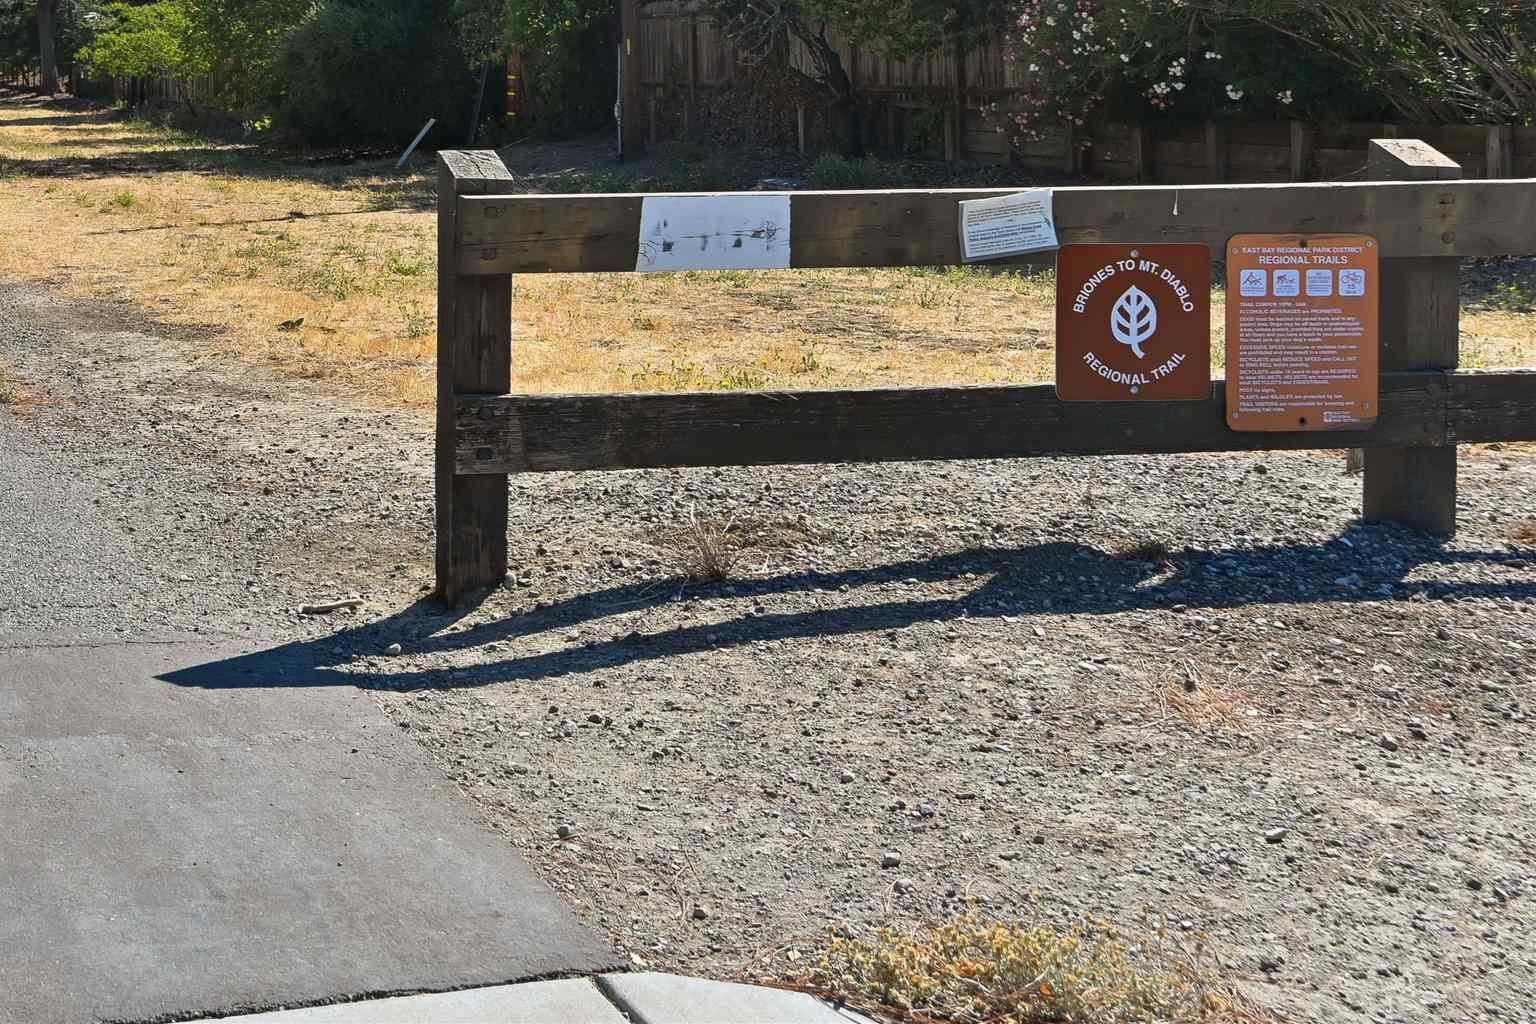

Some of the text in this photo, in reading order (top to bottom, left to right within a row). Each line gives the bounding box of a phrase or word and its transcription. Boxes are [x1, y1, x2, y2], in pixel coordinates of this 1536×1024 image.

[1259, 255, 1349, 265] REGIONAL TRAILS
[1277, 247, 1312, 255] REGIONAL
[1313, 247, 1333, 255] PARK
[1333, 247, 1362, 255] DISTRICT
[1072, 259, 1195, 314] BRIONES TO MT. DIABLO
[1082, 351, 1187, 385] REGIONAL TRAIL
